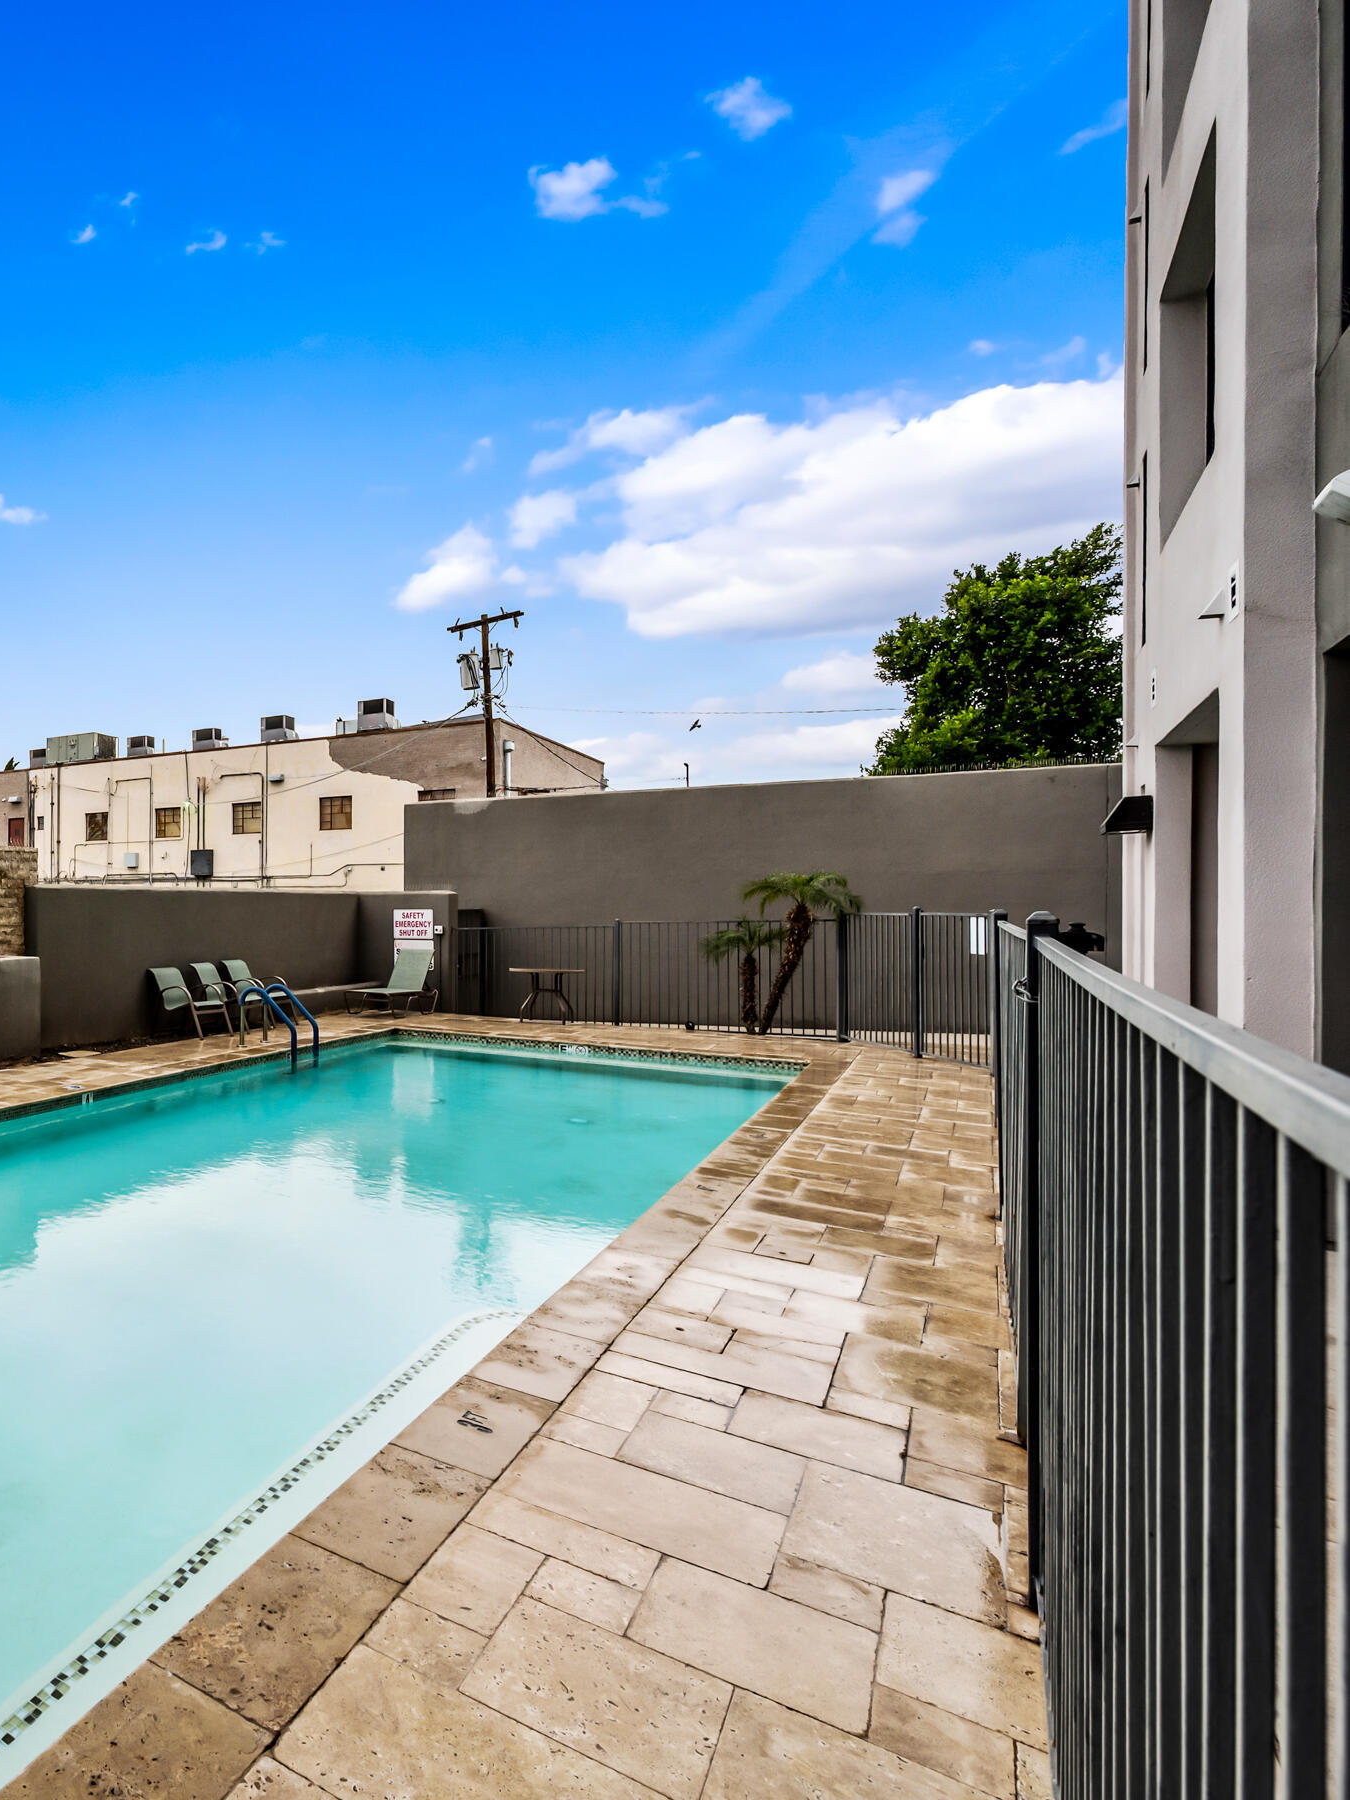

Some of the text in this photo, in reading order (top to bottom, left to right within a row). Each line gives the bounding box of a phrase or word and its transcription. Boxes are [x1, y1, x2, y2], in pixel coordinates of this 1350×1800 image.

[401, 911, 425, 919] SAFETY
[394, 920, 432, 928] EMERGENCY
[399, 929, 428, 937] SHUT OFF
